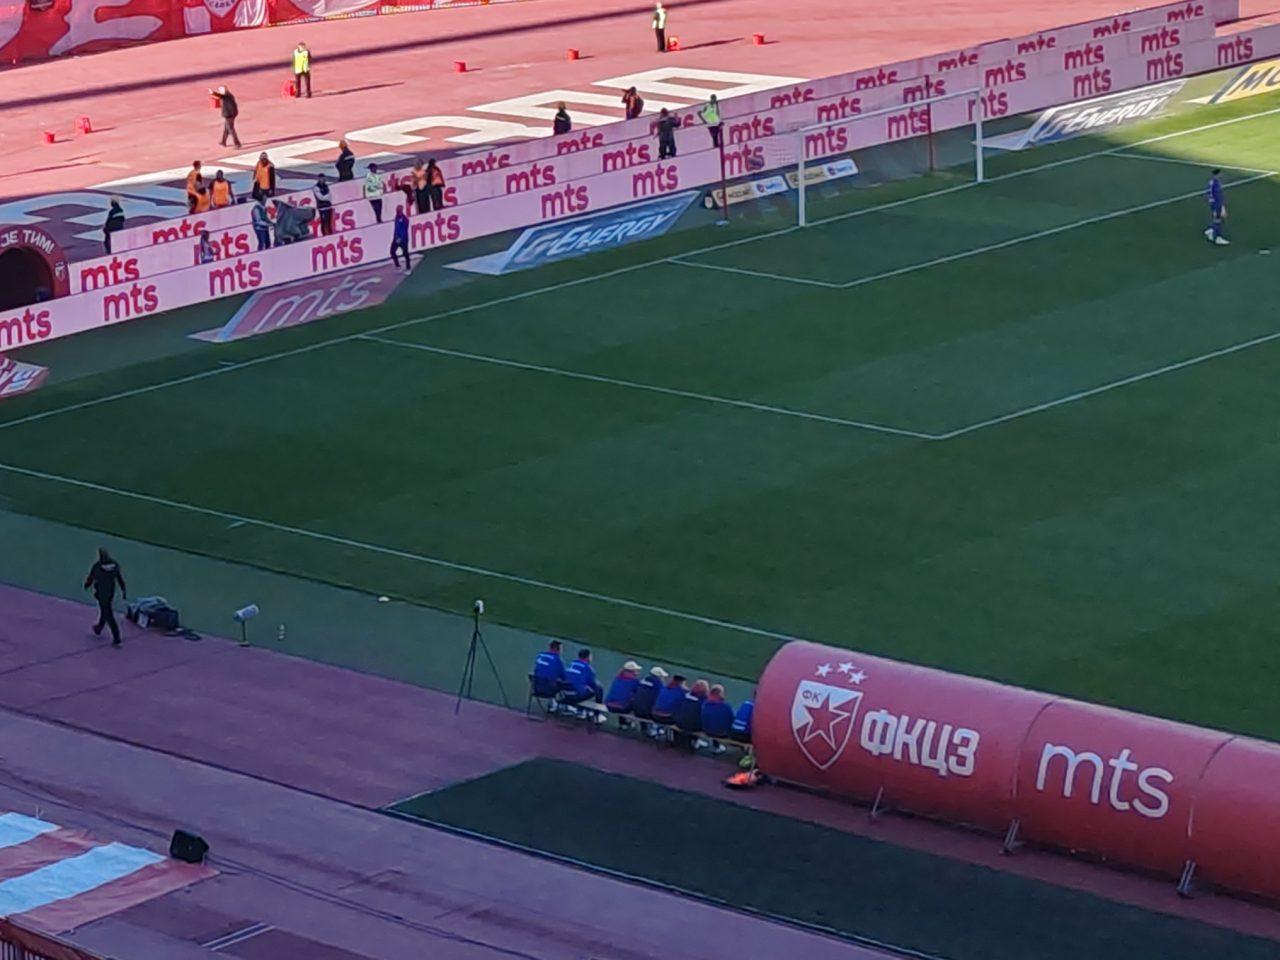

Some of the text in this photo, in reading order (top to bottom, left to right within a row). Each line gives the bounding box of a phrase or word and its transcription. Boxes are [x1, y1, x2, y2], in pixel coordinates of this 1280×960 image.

[80, 256, 140, 292] mts
[506, 162, 556, 194] mts
[602, 140, 651, 173] mts
[729, 114, 775, 146] mts
[817, 96, 862, 123] mts
[903, 78, 946, 104] mts
[985, 60, 1027, 88] mts
[1064, 43, 1105, 71] mts
[1141, 25, 1180, 53] mts
[104, 284, 158, 321] mts
[209, 258, 262, 296] mts
[311, 234, 363, 272] mts
[411, 210, 461, 248] mts
[541, 183, 589, 218] mts
[633, 162, 678, 197] mts
[724, 145, 765, 176] mts
[805, 126, 847, 158] mts
[888, 108, 928, 139] mts
[1073, 67, 1112, 98] mts
[1147, 51, 1183, 81] mts
[1217, 35, 1253, 66] mts
[0, 230, 19, 247] ЈЕ
[22, 229, 55, 254] ТИМ!
[253, 273, 383, 333] mts
[802, 689, 822, 703] ФК
[859, 709, 981, 777] ФКЦЗ
[1035, 742, 1176, 819] mts
